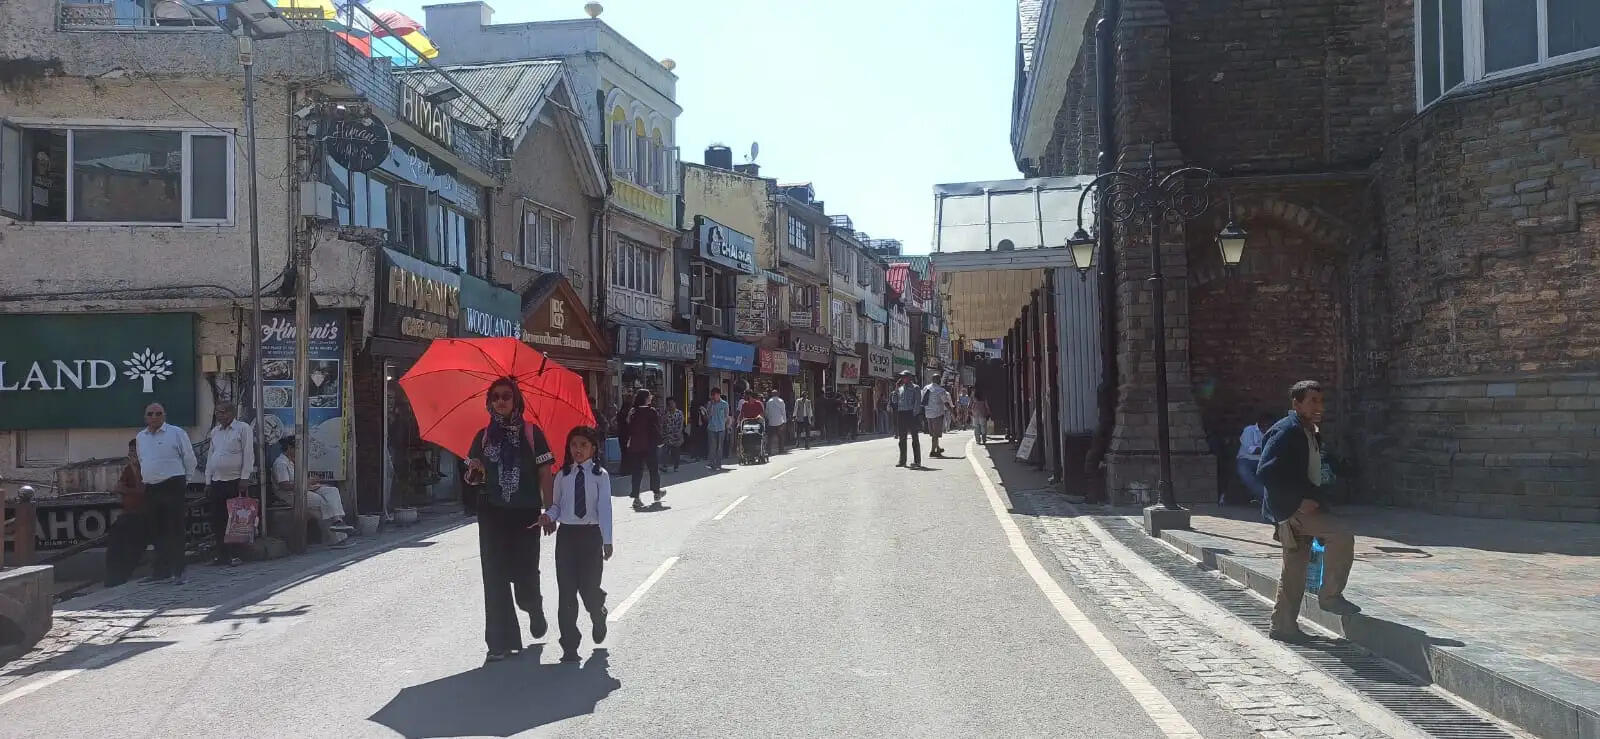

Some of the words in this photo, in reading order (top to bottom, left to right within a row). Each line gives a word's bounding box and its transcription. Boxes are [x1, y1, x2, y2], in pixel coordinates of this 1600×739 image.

[261, 317, 338, 343] Himni's
[466, 307, 511, 339] WOODLAND
[0, 359, 116, 390] LAND
